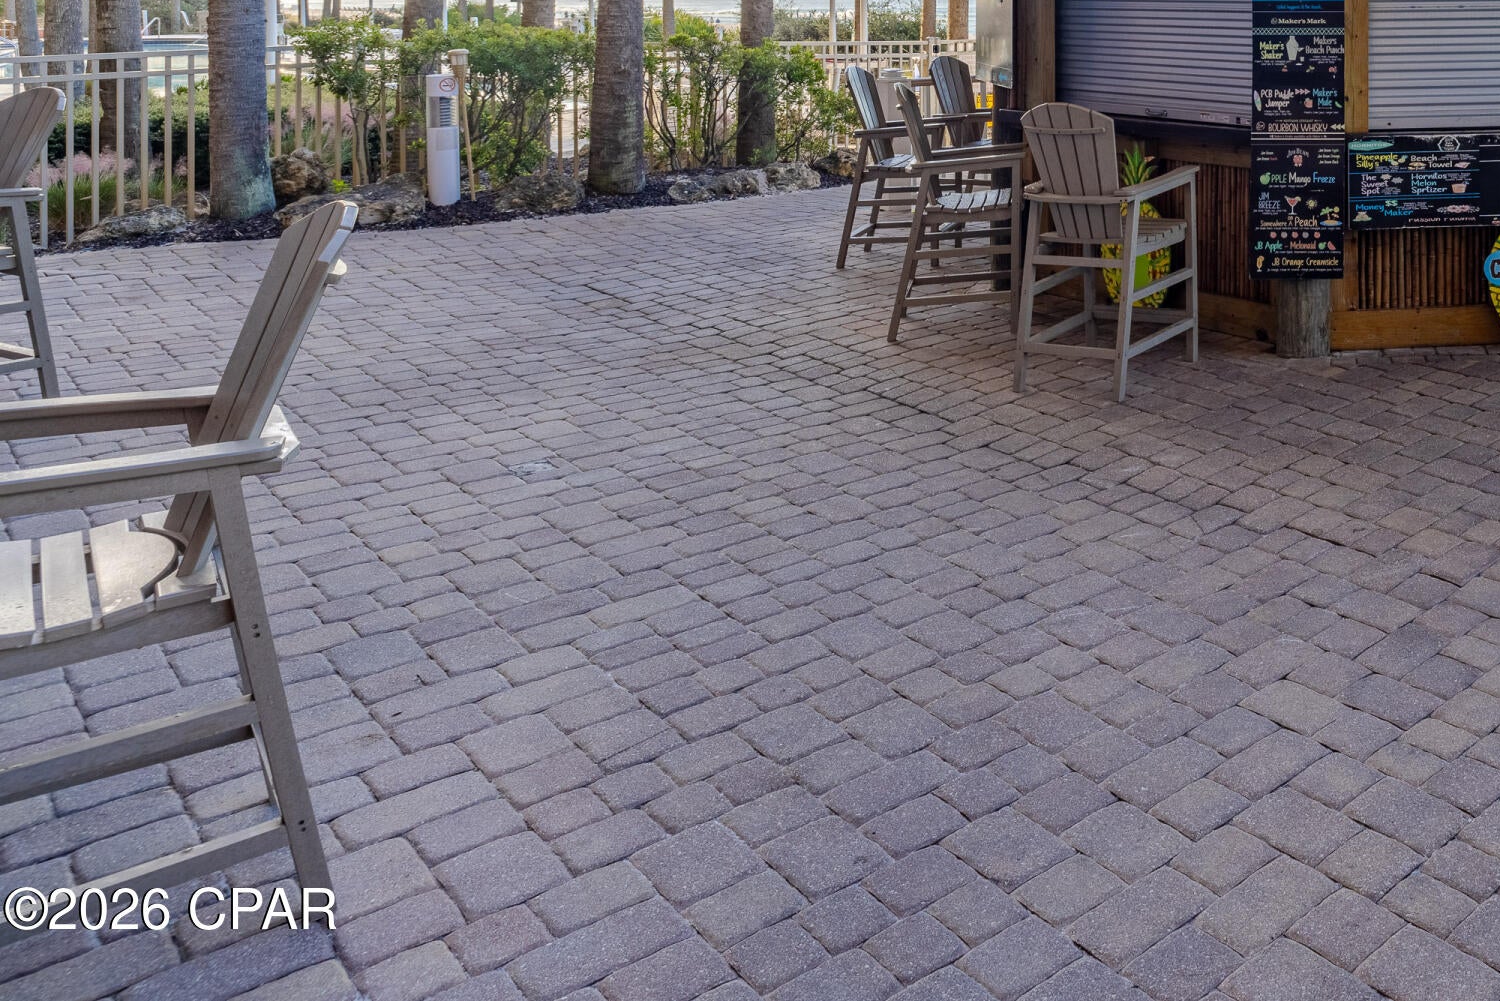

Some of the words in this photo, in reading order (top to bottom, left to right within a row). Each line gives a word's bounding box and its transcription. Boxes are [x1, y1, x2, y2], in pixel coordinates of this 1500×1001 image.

[1305, 45, 1325, 54] Beach
[1260, 50, 1284, 60] Shaker
[1260, 89, 1273, 98] PCB
[1300, 123, 1328, 132] WHISKY
[1355, 152, 1399, 162] Pineapple
[1288, 172, 1312, 187] Mango
[1312, 171, 1336, 184] Freeze
[1361, 180, 1389, 188] Sweet
[1361, 187, 1380, 196] Spot
[1355, 203, 1385, 212] Money
[1294, 215, 1318, 227] Peach
[1264, 241, 1283, 253] Apple
[1281, 257, 1304, 269] Orange
